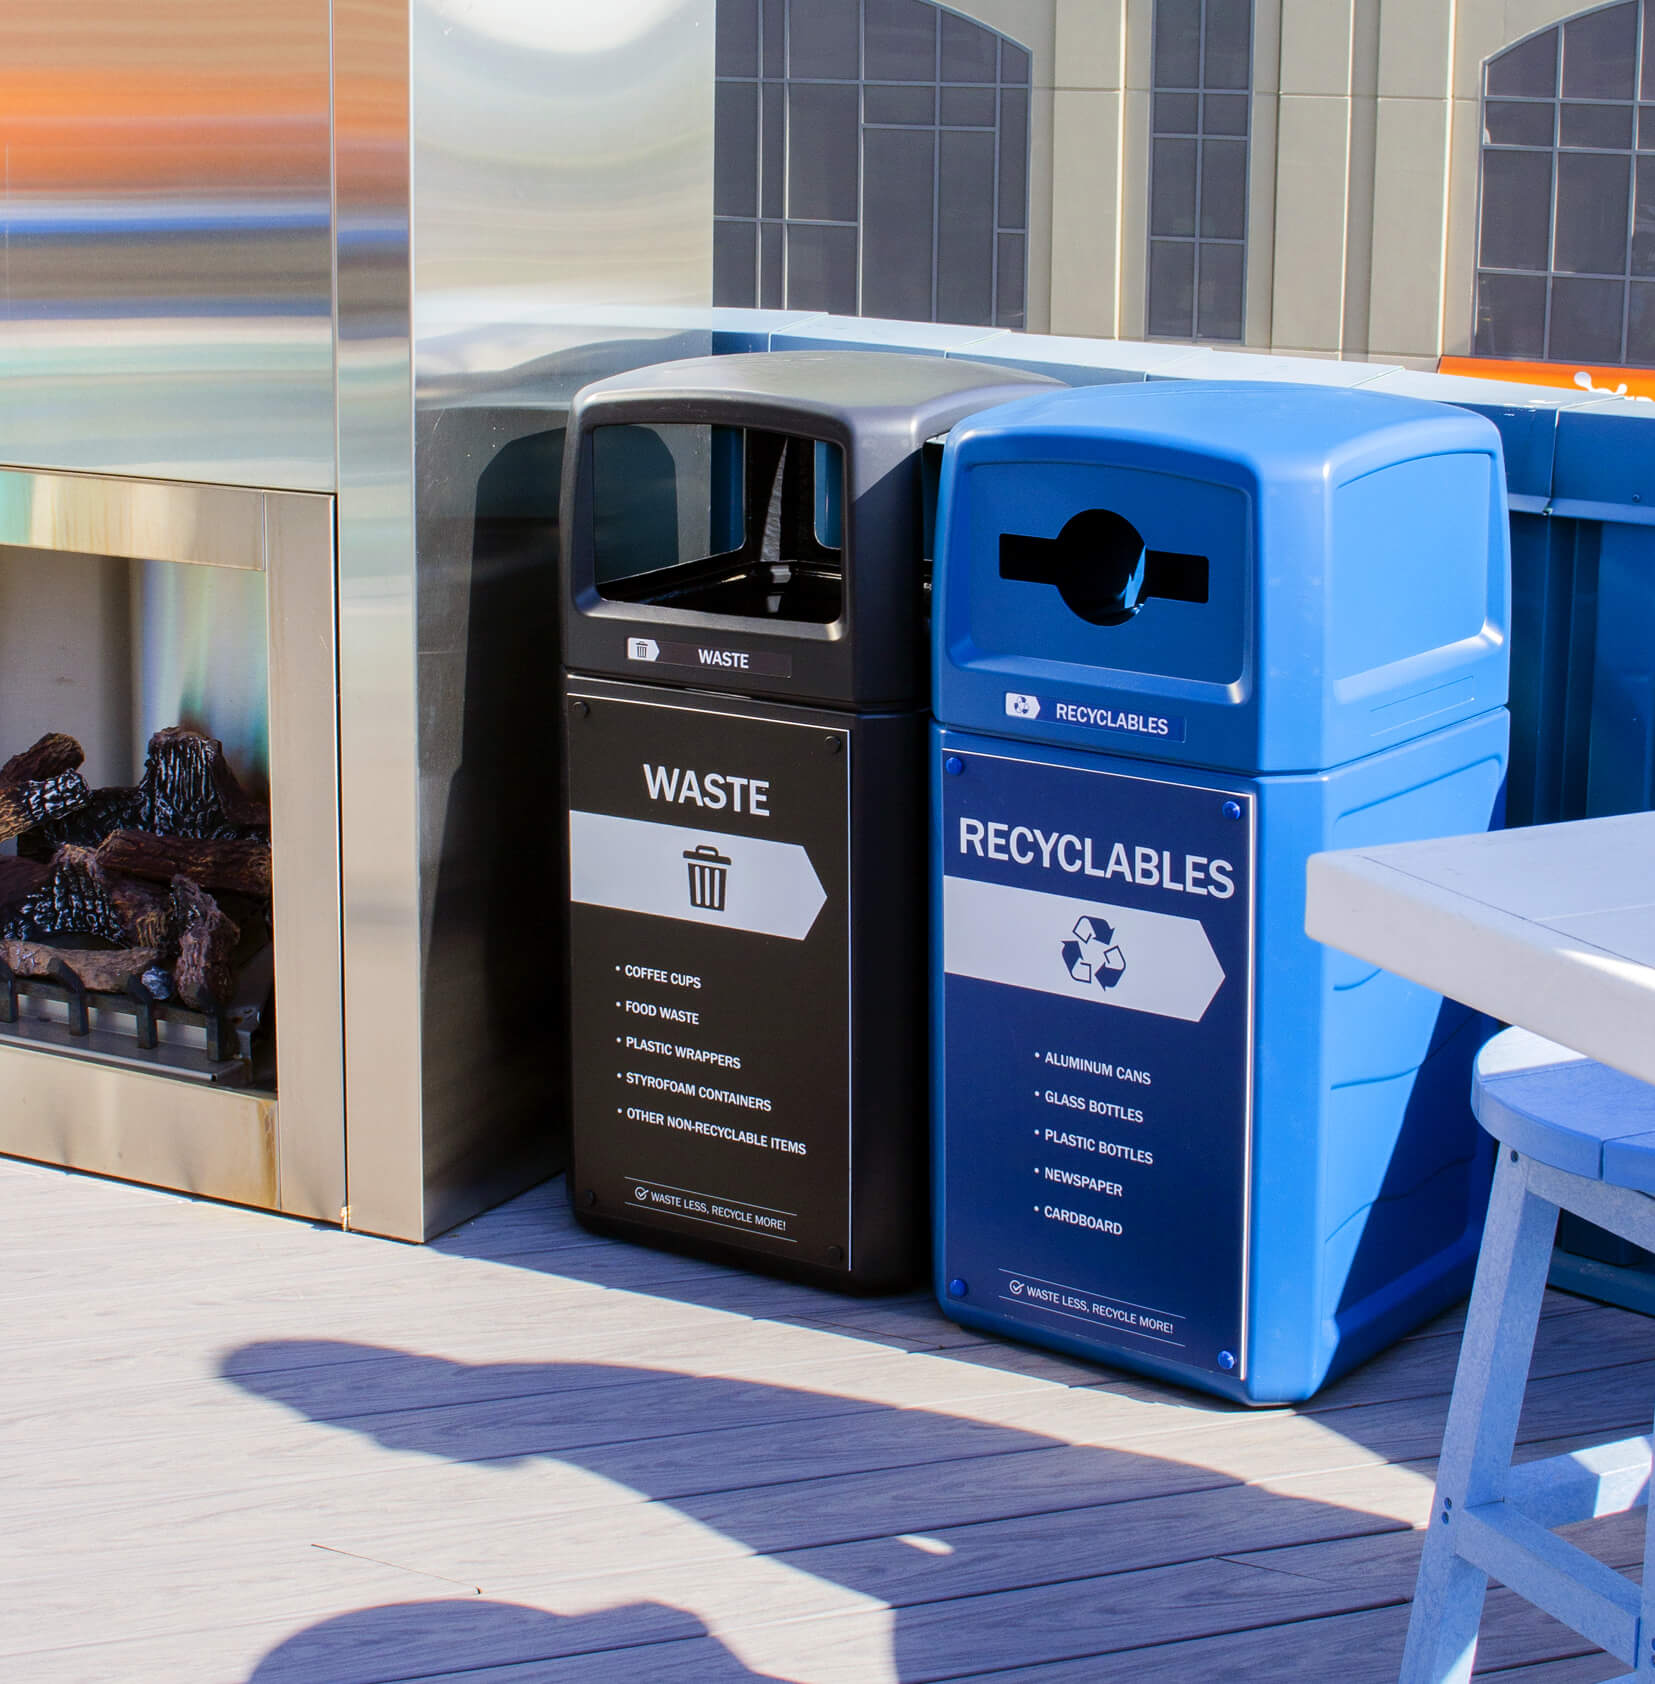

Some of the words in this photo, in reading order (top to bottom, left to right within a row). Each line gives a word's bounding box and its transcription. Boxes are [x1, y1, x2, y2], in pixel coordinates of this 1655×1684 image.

[698, 648, 749, 669] WASTE
[1056, 703, 1169, 735] RECYCLABLES
[643, 763, 770, 817] WASTE
[959, 816, 1235, 899] RECYCLABLES
[625, 964, 668, 983] COFFEE
[670, 972, 701, 989] CUPS
[625, 1000, 657, 1017] FOOD
[660, 1006, 699, 1025] WASTE
[626, 1036, 672, 1056] PLASTIC
[674, 1045, 741, 1069] WRAPPERS
[1045, 1051, 1113, 1077] ALUMINUM
[1116, 1066, 1151, 1085] CANS
[626, 1071, 695, 1096] STYROFOAM
[698, 1086, 772, 1112] CONTAINERS
[1044, 1090, 1086, 1110] GLASS
[1089, 1100, 1143, 1123] BOTTLES
[626, 1106, 664, 1126] OTHER
[667, 1115, 768, 1148] NON-RECYCLABLE
[770, 1137, 806, 1155] ITEMS
[1045, 1129, 1095, 1151] PLASTIC
[1099, 1141, 1153, 1165] BOTTLES
[1044, 1167, 1123, 1197] NEWSPAPER
[650, 1191, 681, 1208] WASTE
[683, 1198, 710, 1215] LESS,
[711, 1204, 752, 1223] RECYCLE
[755, 1214, 786, 1232] MORE!
[1044, 1205, 1123, 1235] CARDBOARD
[1027, 1285, 1060, 1304] WASTE
[1062, 1295, 1090, 1312] LESS,
[1092, 1303, 1136, 1325] RECYCLE
[1139, 1316, 1173, 1334] MORE!
